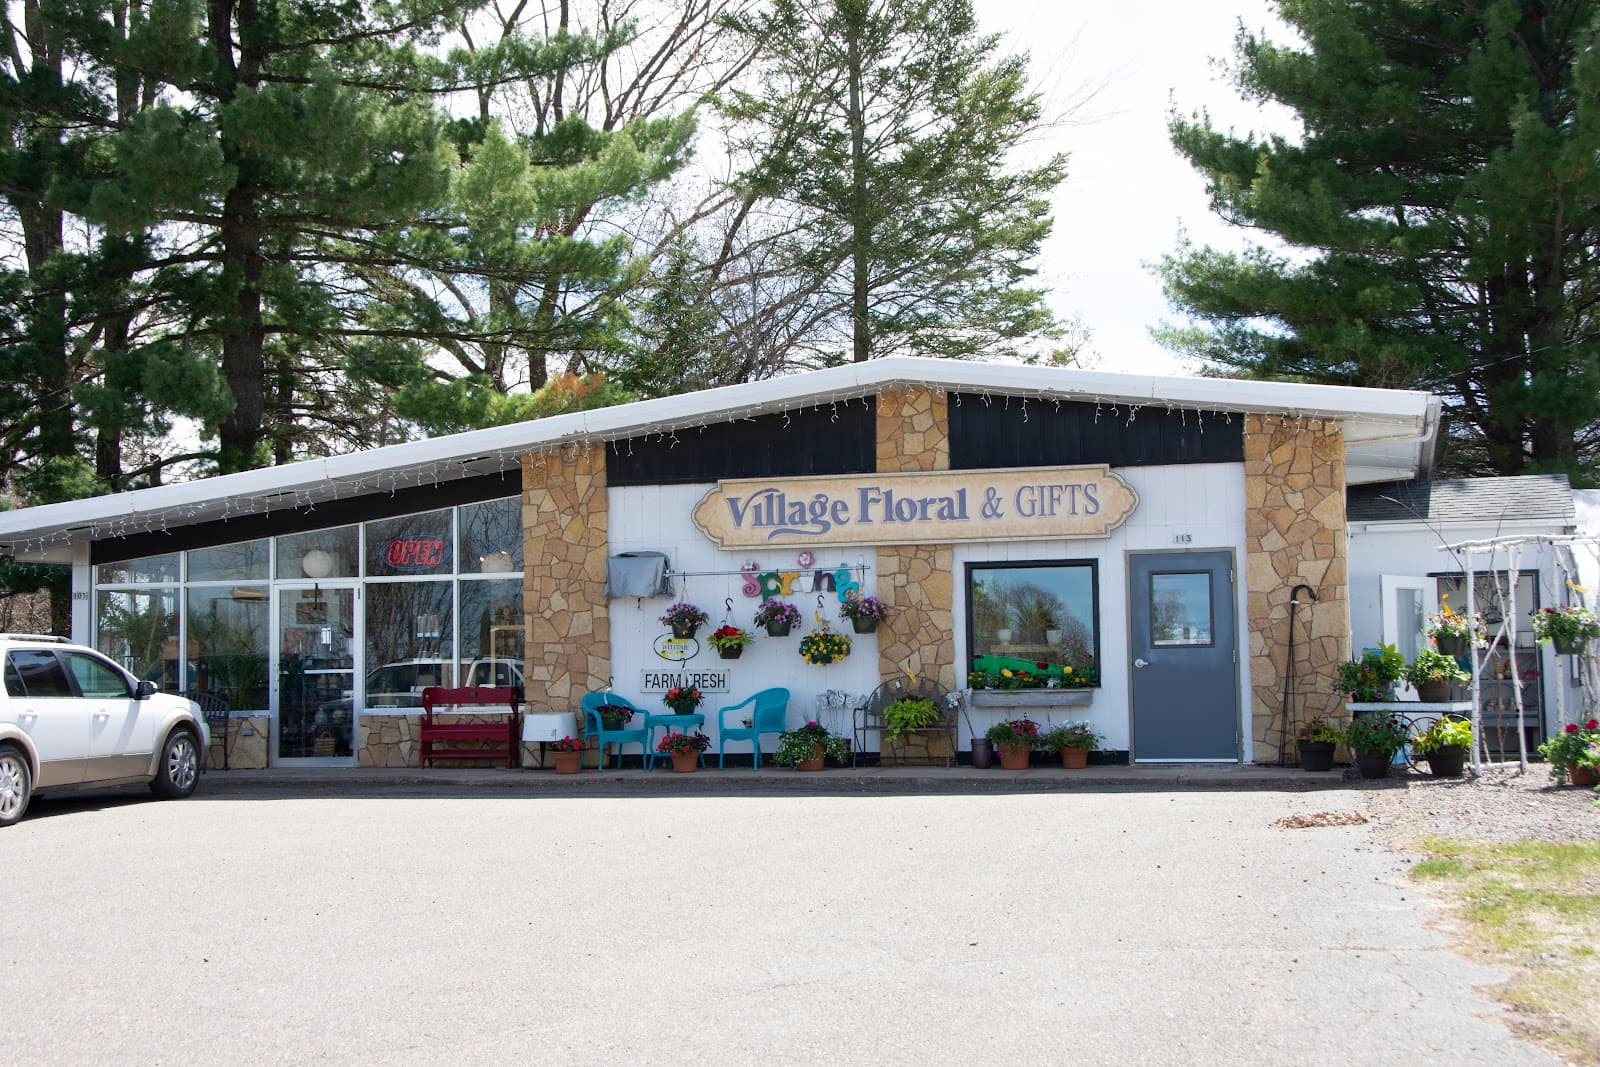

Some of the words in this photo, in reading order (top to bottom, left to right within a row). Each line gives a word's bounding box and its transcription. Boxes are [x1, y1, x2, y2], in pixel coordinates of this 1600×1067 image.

[726, 488, 850, 541] Village
[857, 487, 969, 523] Floral
[981, 486, 1005, 519] &
[1015, 483, 1100, 518] GIFTS
[387, 539, 445, 565] OPEN
[645, 673, 681, 688] FARM
